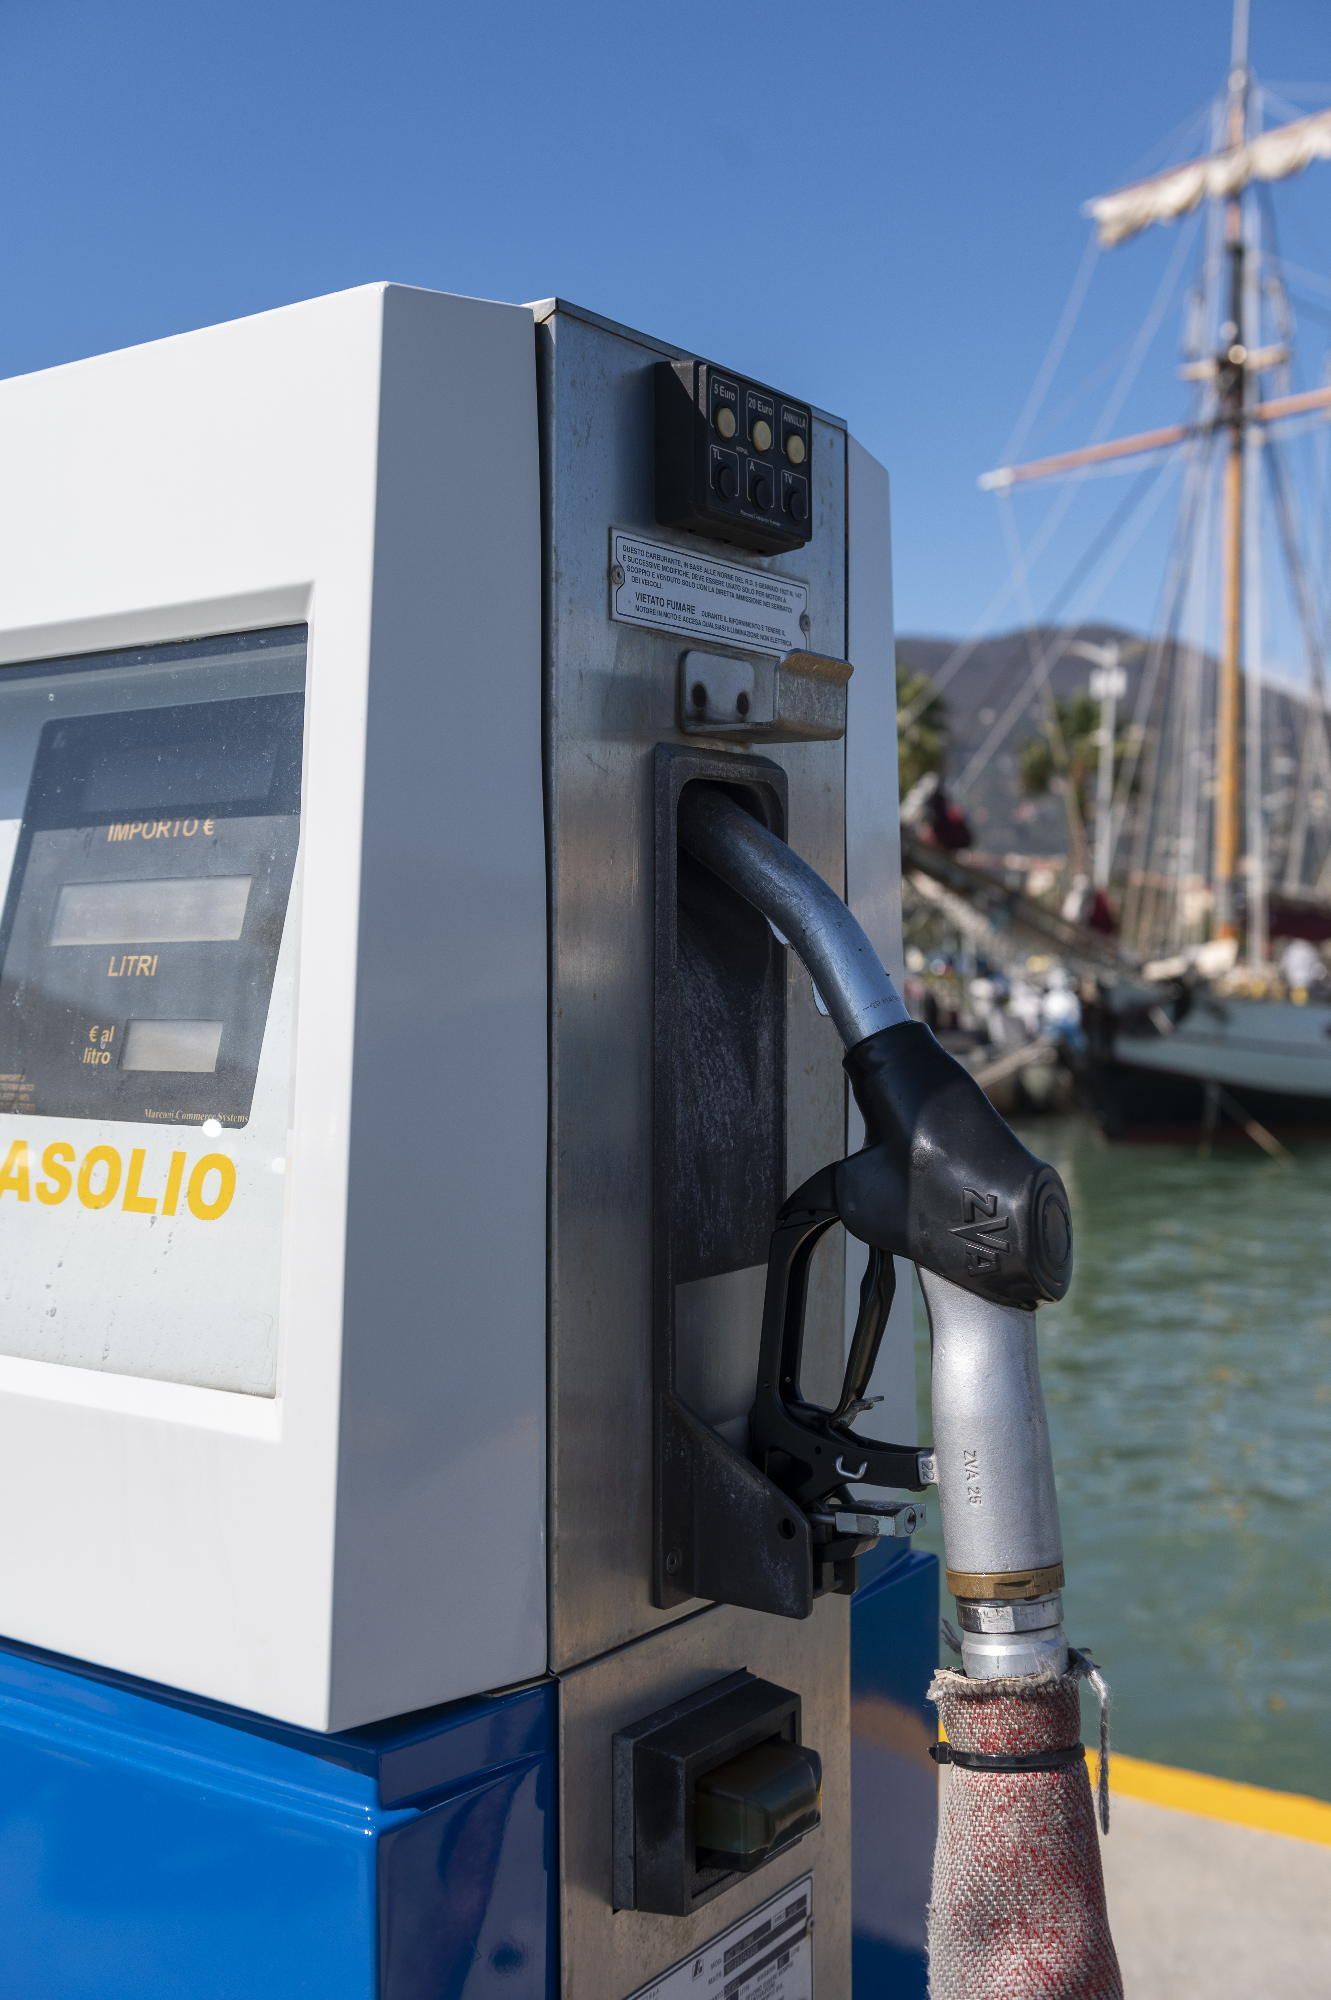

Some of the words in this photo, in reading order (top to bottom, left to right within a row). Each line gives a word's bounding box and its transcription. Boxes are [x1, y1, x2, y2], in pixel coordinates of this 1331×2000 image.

[714, 383, 718, 394] 5
[719, 385, 735, 400] Euro
[748, 397, 756, 407] 20
[758, 401, 772, 415] Euro
[784, 411, 806, 427] ANNULLA
[713, 447, 721, 460] TL
[750, 462, 755, 471] A
[784, 473, 792, 484] TV
[623, 545, 644, 556] QUESTO
[646, 551, 683, 568] CARBURANTE,
[690, 563, 702, 573] BASE
[704, 567, 716, 576] ALLE
[717, 571, 734, 581] NORME
[735, 576, 744, 584] DEL
[627, 565, 651, 577] SCOPPIO
[657, 573, 681, 585] VENDUTO
[682, 579, 696, 589] SOLO
[697, 583, 707, 592] CON
[716, 588, 734, 598] DIRETTA
[736, 593, 762, 606] IMMISSIONE
[628, 556, 660, 570] SUCCESSIVE
[662, 565, 690, 579] MODIFICHE,
[692, 573, 704, 582] DEVE
[706, 577, 725, 587] ESSERE
[726, 582, 741, 592] USATO
[742, 586, 755, 595] SOLO
[756, 590, 765, 598] PER
[766, 593, 782, 602] MOTORI
[632, 576, 640, 584] DEI
[635, 592, 664, 607] VIETATO
[667, 599, 696, 615] FUMARE
[702, 610, 723, 621] DURANTE
[766, 626, 781, 636] TENERE
[635, 605, 656, 615] MOTORE
[664, 611, 677, 620] MOTO
[683, 615, 702, 626] ACCESA
[702, 620, 727, 632] QUALSIASI
[760, 634, 769, 642] NON
[770, 636, 792, 647] ELETTRICA
[108, 818, 198, 842] IMPORTO
[203, 818, 215, 836] €
[108, 955, 158, 977] LITRI
[89, 1025, 99, 1043] €
[102, 1025, 114, 1043] al
[83, 1047, 111, 1065] litro
[145, 1109, 174, 1119] Marconi
[176, 1110, 217, 1121] Commerce
[218, 1112, 249, 1123] Systems
[948, 1187, 1010, 1277] ZVA
[921, 1461, 934, 1480] 22
[963, 1450, 980, 1481] ZVA
